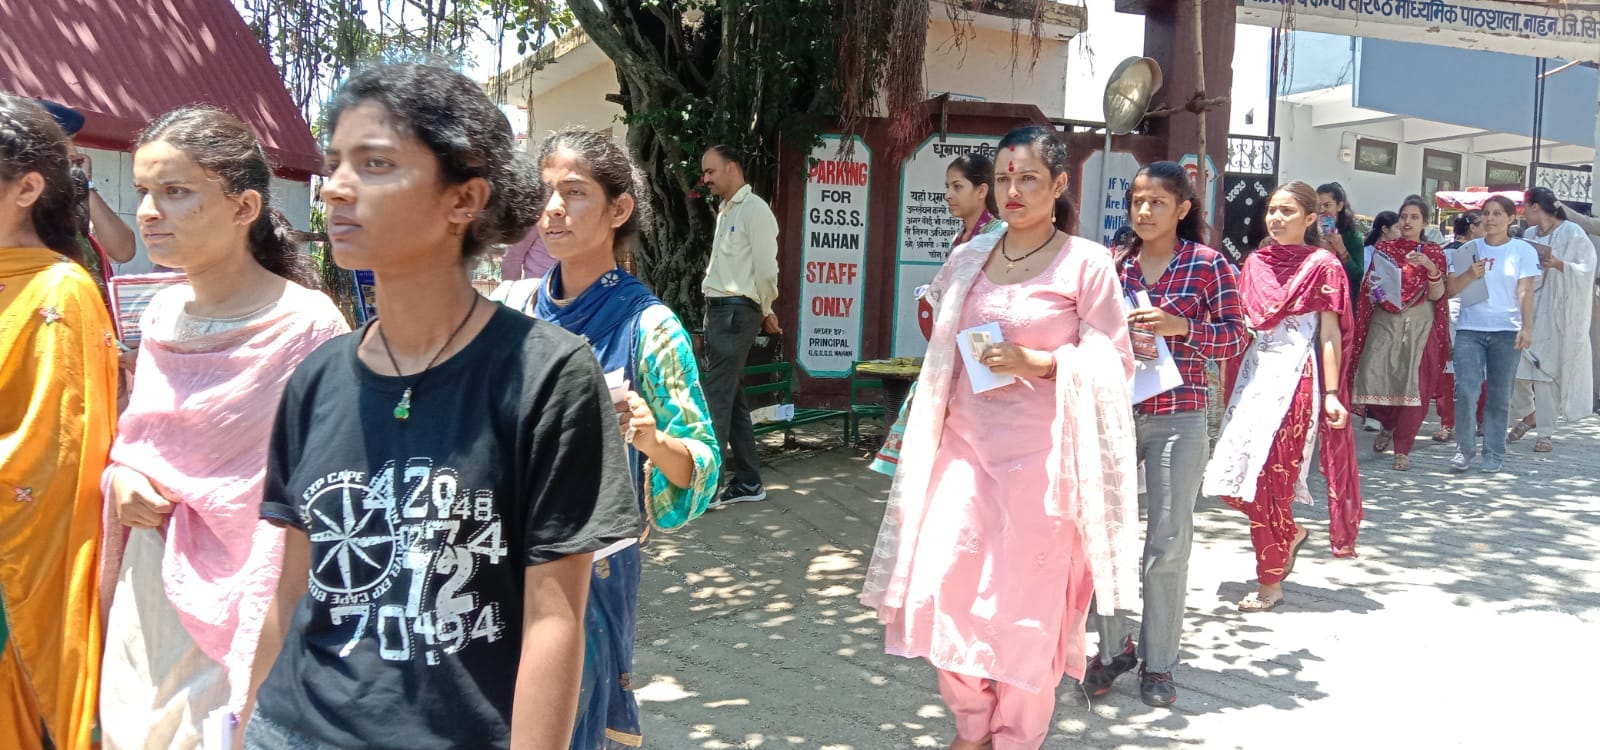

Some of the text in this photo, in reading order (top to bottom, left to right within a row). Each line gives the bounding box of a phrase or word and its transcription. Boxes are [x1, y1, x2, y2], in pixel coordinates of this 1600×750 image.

[807, 159, 868, 186] PARKING
[1120, 178, 1130, 191] Yo
[821, 189, 852, 204] FOR
[1105, 197, 1121, 210] Are
[809, 207, 864, 227] G.S.S.S.
[810, 231, 860, 250] NAHAN
[806, 261, 858, 285] STAFF
[811, 295, 854, 318] ONLY
[809, 337, 849, 348] PRINCIPAL
